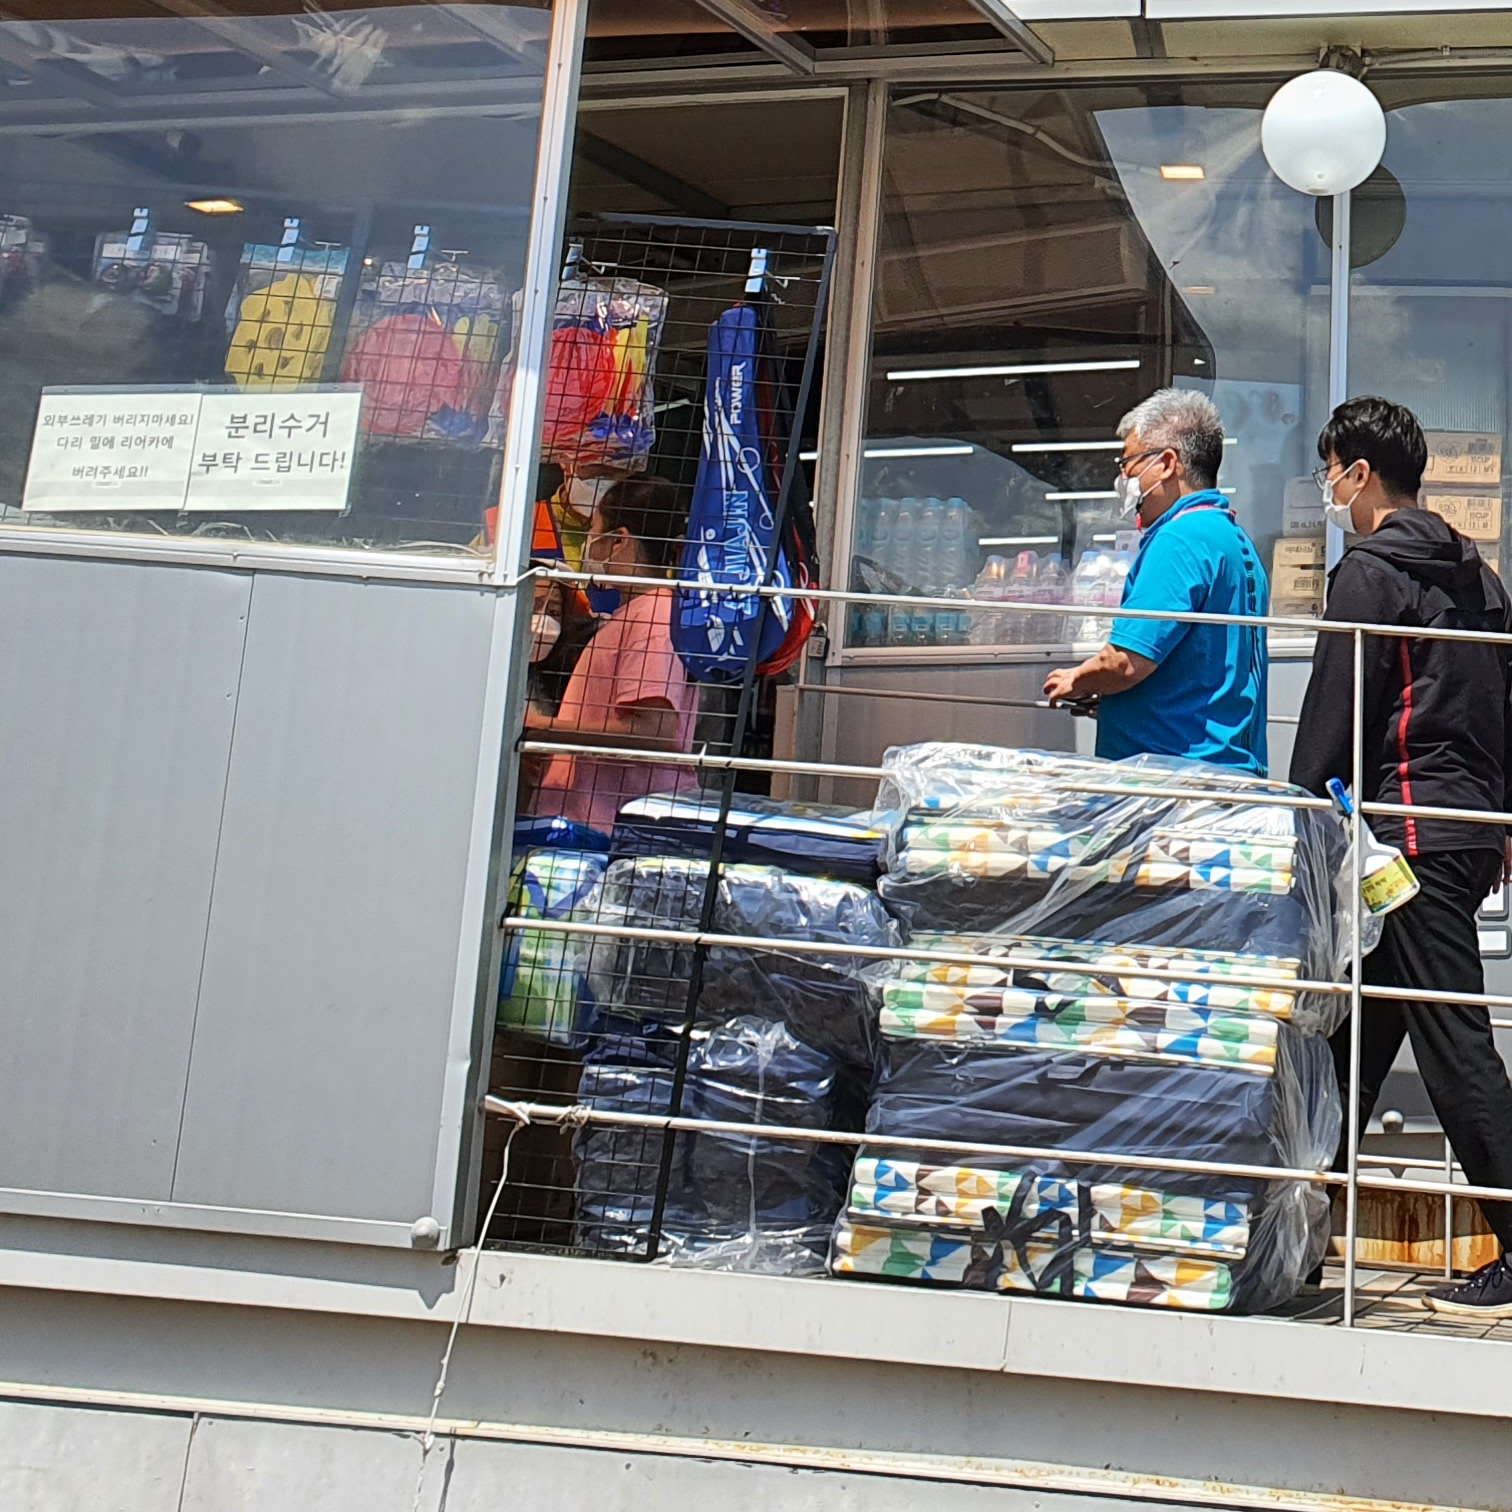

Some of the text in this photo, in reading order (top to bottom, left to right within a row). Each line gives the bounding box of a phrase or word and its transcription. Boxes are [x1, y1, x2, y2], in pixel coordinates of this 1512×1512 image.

[42, 413, 108, 427] 외부쓰레기
[225, 411, 330, 439] 분리수거
[57, 436, 83, 449] 다리
[120, 435, 175, 449] 리어카에
[198, 450, 346, 475] 부탁 드립니다!
